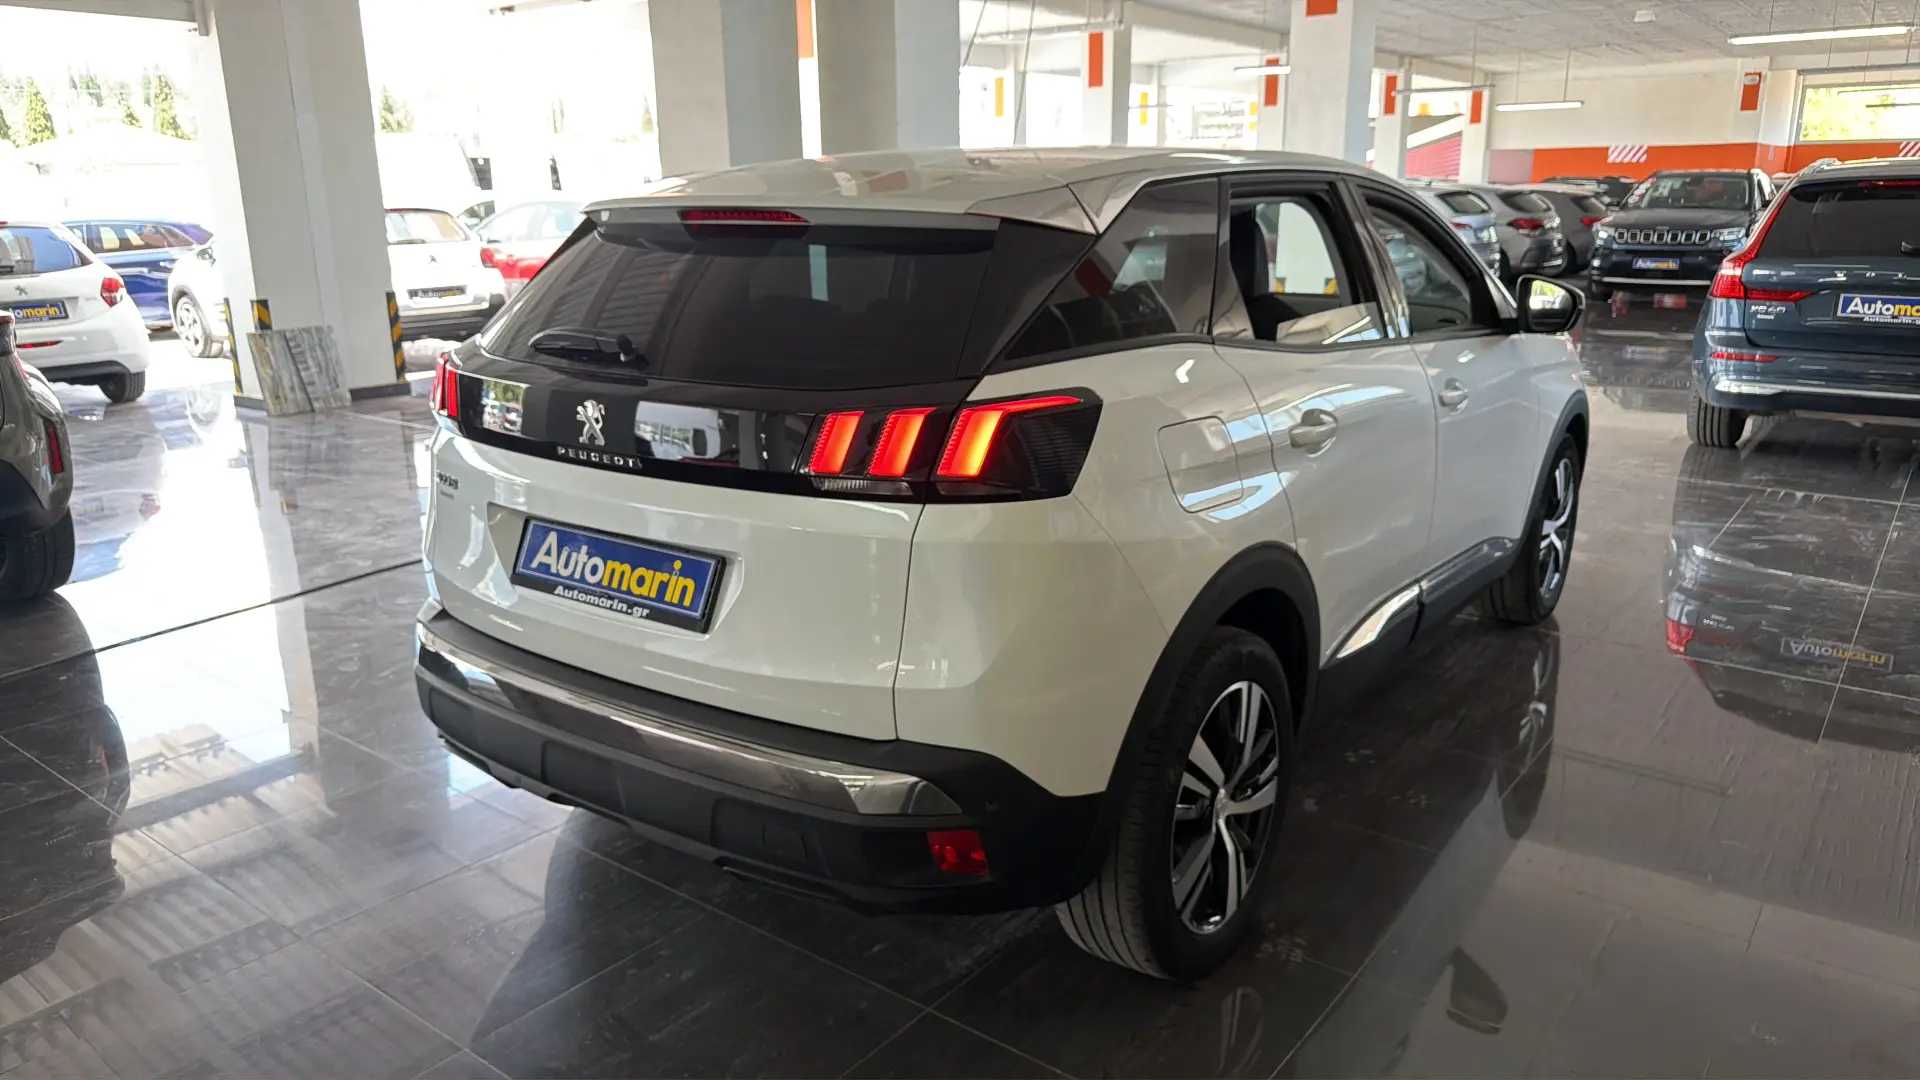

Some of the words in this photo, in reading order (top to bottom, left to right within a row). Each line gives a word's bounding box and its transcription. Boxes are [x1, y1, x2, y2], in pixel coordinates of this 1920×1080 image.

[557, 446, 636, 468] PEUGEOT
[530, 531, 696, 607] Automarin
[553, 585, 650, 617] Automarin.gr
